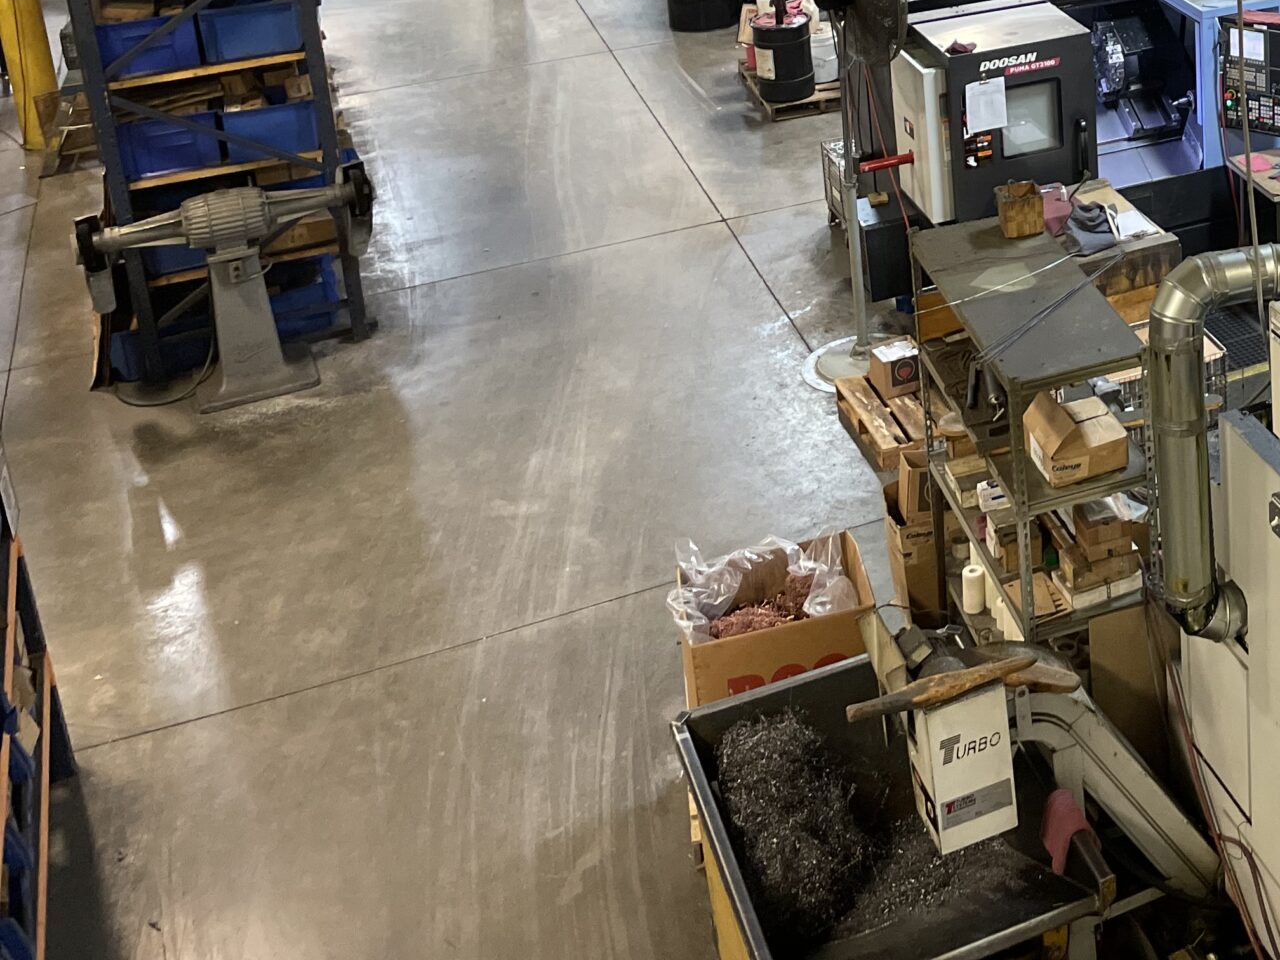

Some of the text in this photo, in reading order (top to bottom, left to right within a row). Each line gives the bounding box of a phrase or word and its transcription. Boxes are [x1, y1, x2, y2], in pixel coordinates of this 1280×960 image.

[979, 52, 1037, 72] DOOSAN
[1009, 59, 1056, 74] PUMA GT2100
[939, 731, 1002, 766] TURBO
